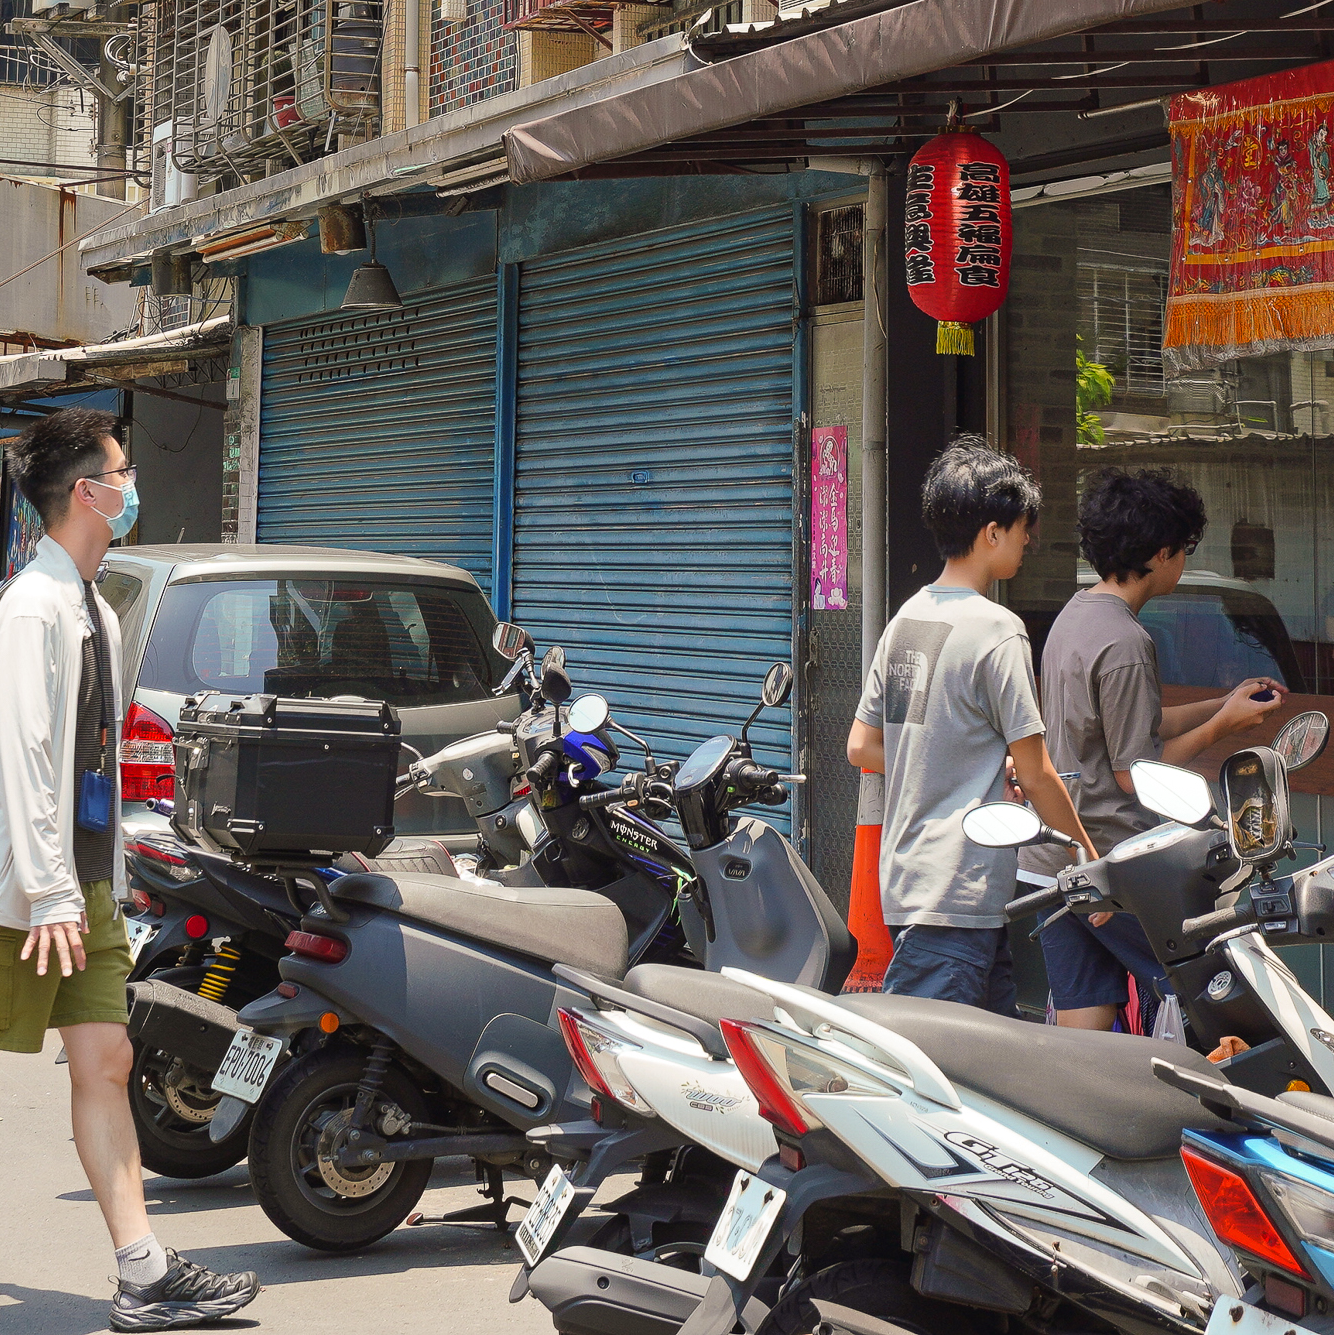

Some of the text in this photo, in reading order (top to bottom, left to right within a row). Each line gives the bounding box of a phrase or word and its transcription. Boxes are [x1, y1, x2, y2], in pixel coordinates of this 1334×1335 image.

[610, 819, 658, 851] MONSTER
[616, 834, 651, 854] ENERGY
[219, 1044, 274, 1088] EPU-7006
